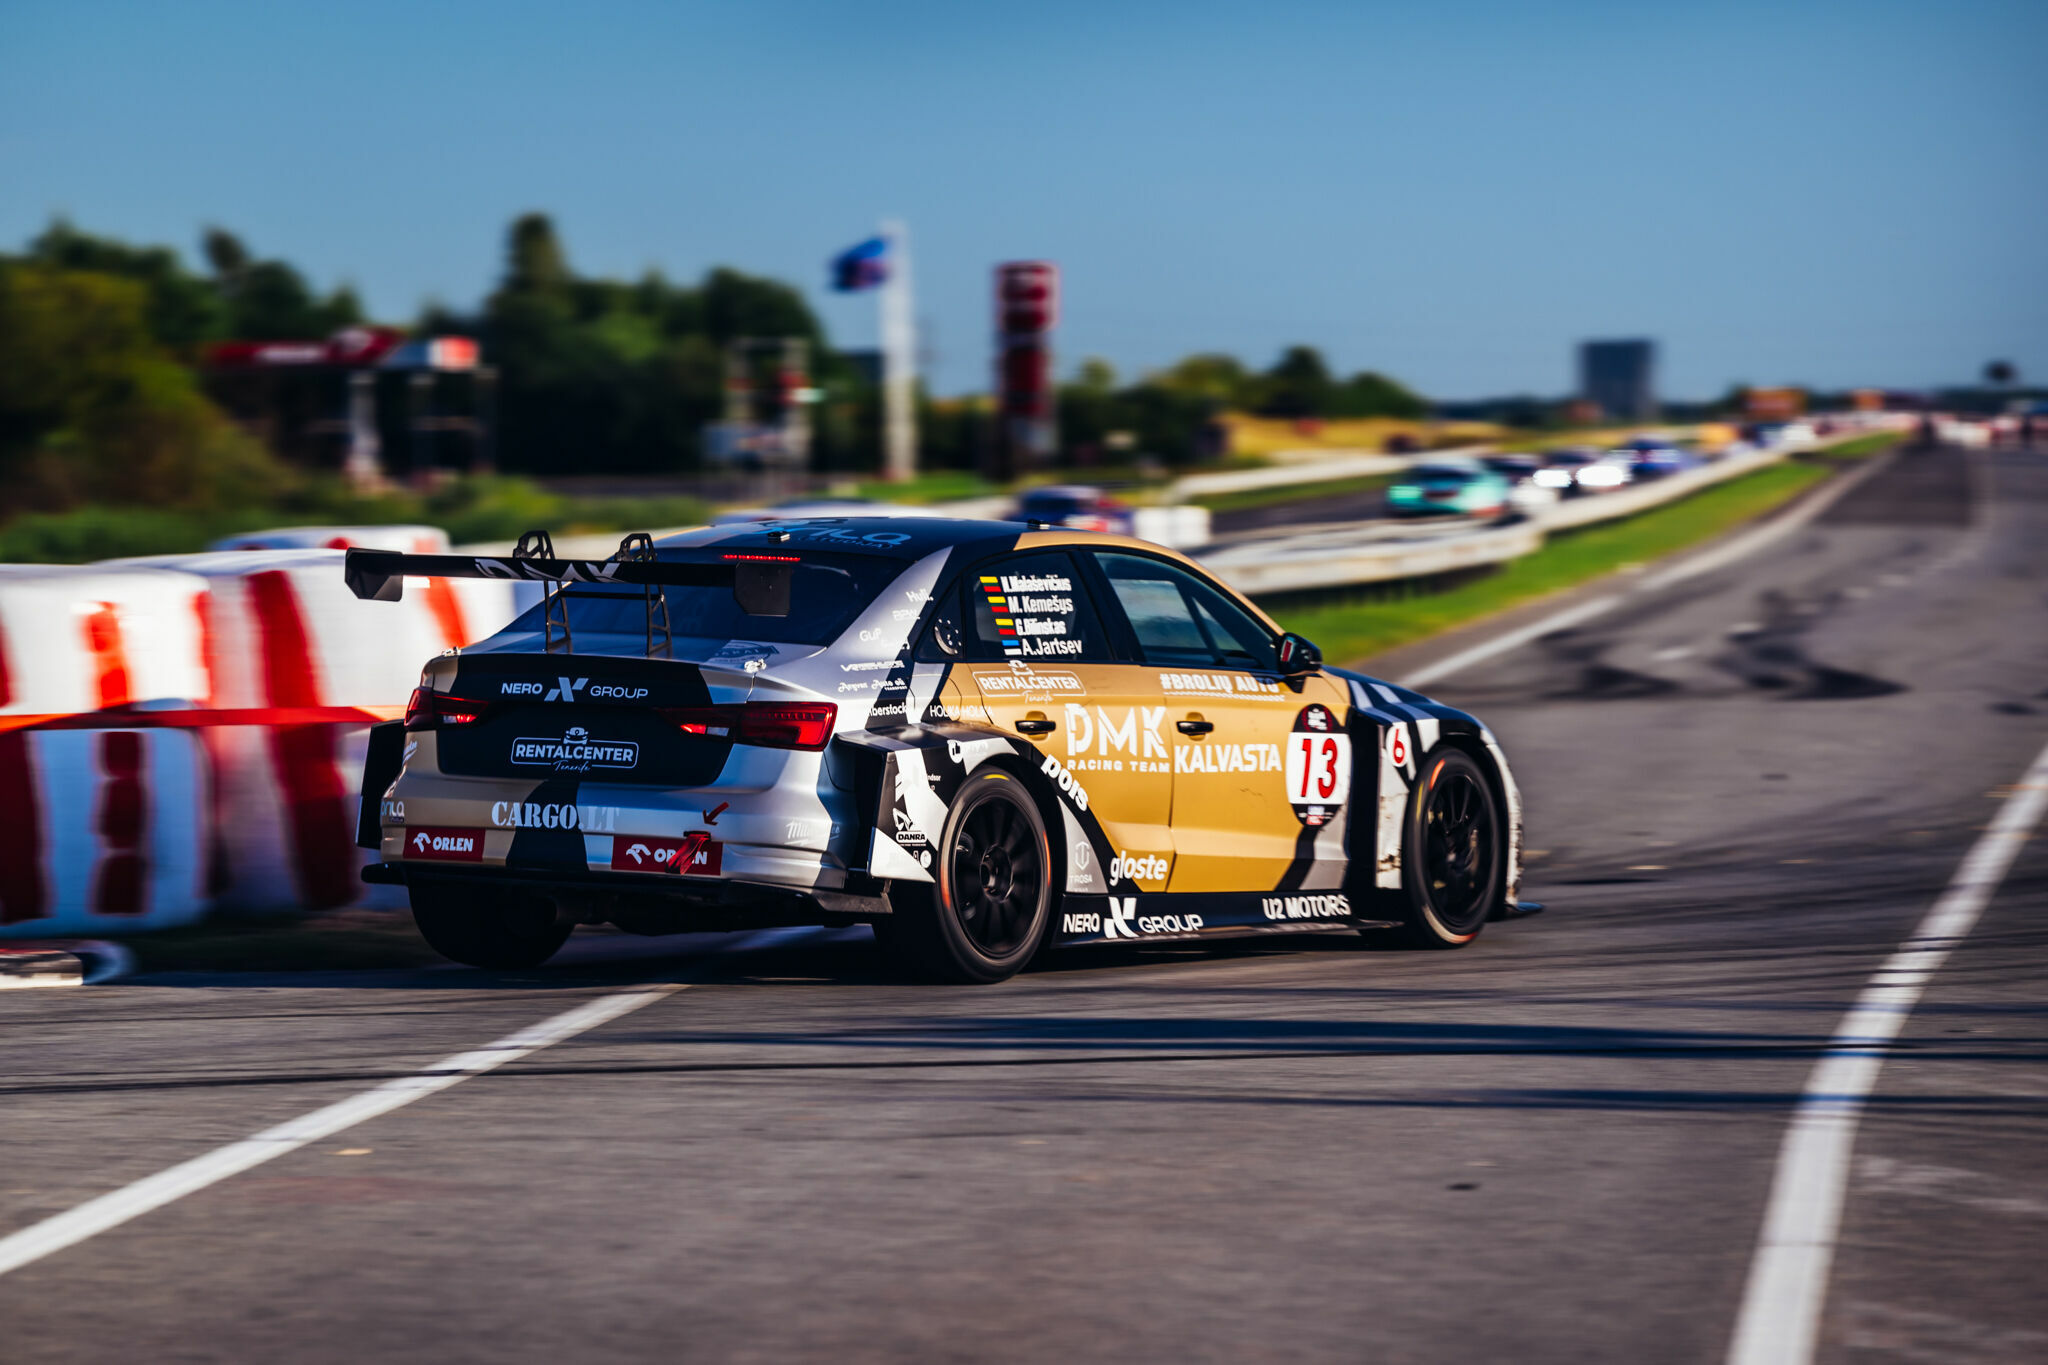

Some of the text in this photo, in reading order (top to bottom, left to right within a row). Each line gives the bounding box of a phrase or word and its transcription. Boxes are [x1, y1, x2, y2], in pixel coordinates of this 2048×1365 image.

[501, 682, 543, 695] NERO
[590, 685, 649, 699] GROUP
[978, 676, 1081, 690] RENTALCENTER
[1064, 703, 1169, 759] DMK
[515, 744, 634, 763] RENTALCENTER
[1393, 728, 1406, 764] 6
[550, 759, 591, 773] Tenerife
[1067, 759, 1170, 773] RACING TEAM
[1174, 743, 1283, 774] KALVASTA
[1301, 737, 1338, 799] 13
[491, 801, 620, 831] CARGO.LT
[432, 836, 474, 852] ORLEN
[898, 833, 926, 841] DANRA
[1109, 850, 1168, 887] gloste
[1262, 895, 1351, 920] U2 MOTORS
[1063, 912, 1100, 933] NERO
[1138, 914, 1204, 934] GROUP
